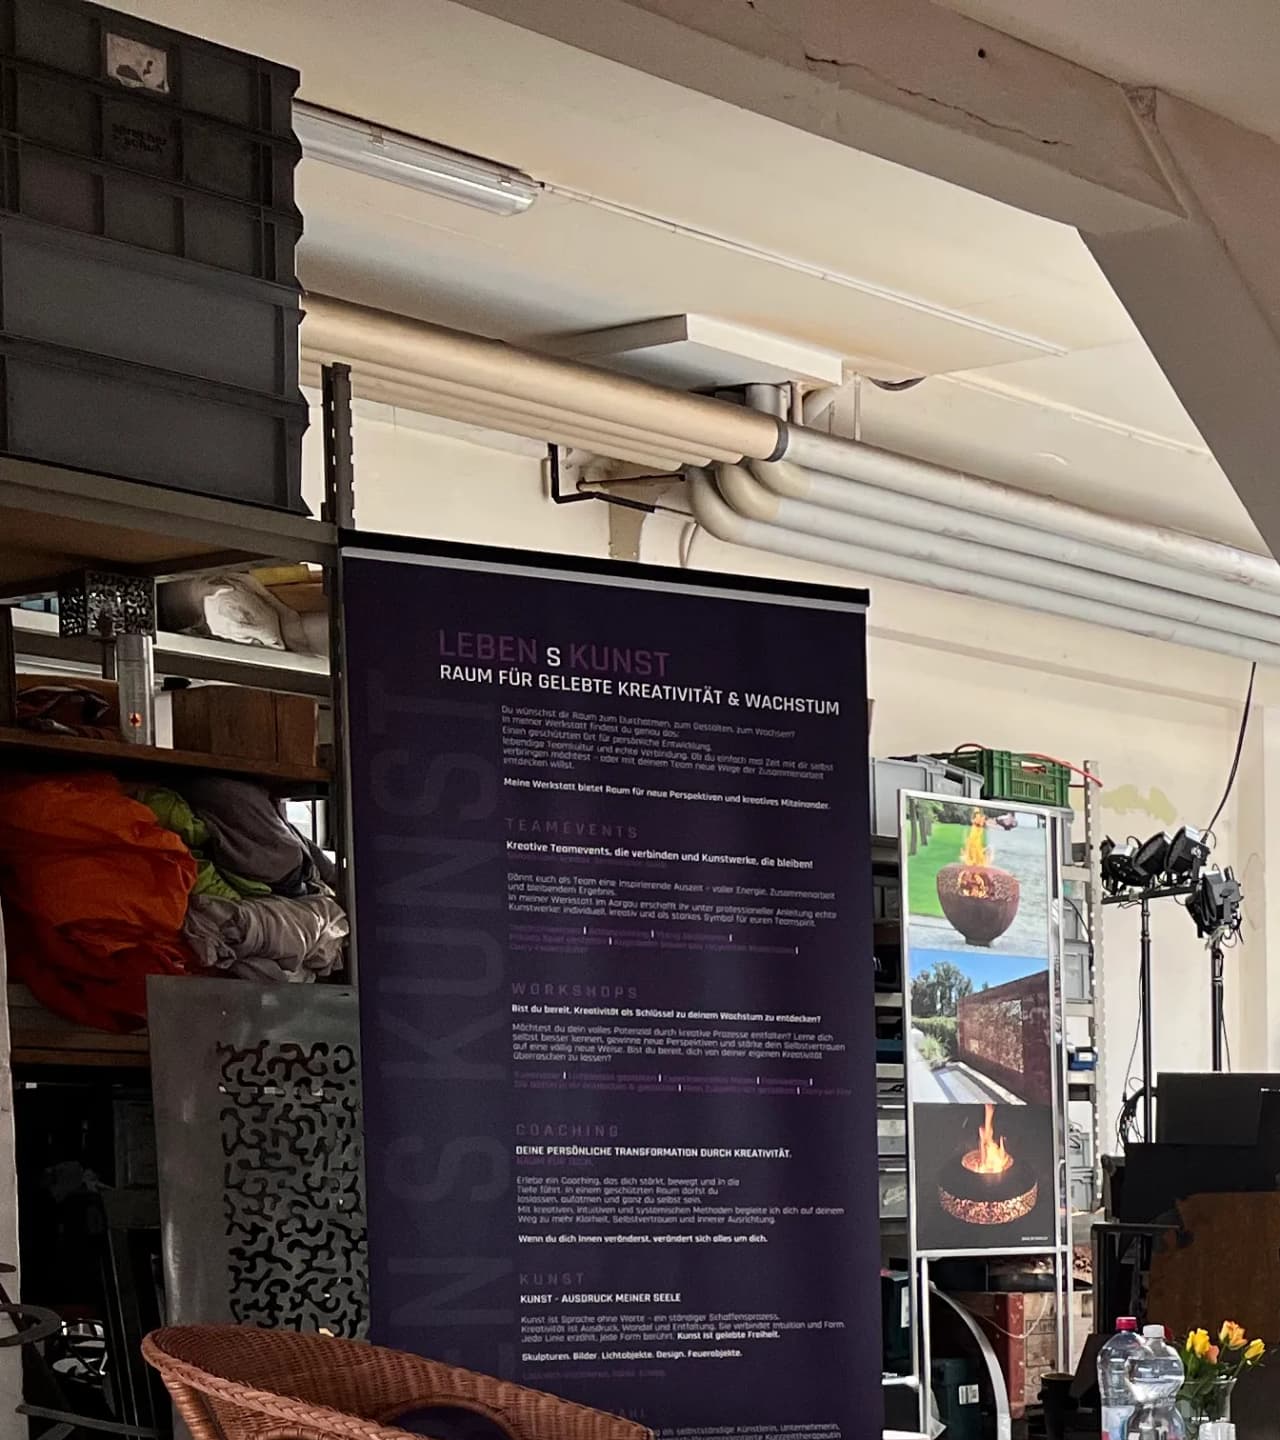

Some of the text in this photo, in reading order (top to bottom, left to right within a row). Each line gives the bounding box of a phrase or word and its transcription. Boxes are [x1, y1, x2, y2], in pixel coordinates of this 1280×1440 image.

[439, 628, 671, 678] LEBEN S KUNST
[440, 666, 840, 716] RAUM FÜR GELEBTE KREATIVITÄT & WACHSTUM
[502, 706, 513, 714] Du
[504, 778, 530, 787] Meine
[532, 780, 574, 790] Werkstatt
[578, 783, 602, 792] bietet
[605, 785, 630, 794] Raum
[632, 787, 644, 795] für
[669, 790, 723, 802] Perspektiven
[724, 794, 740, 802] und
[742, 795, 778, 804] kreatives
[781, 798, 832, 808] Miteinander.
[504, 817, 639, 838] TEAMEVENTS
[506, 841, 547, 852] Kreative
[614, 848, 629, 857] die
[631, 849, 678, 860] verbinden
[681, 852, 699, 861] und
[760, 857, 774, 866] die
[777, 858, 814, 868] bleiben!
[511, 982, 638, 999] WORKSHOPS
[512, 1004, 528, 1013] Bist
[530, 1005, 542, 1013] du
[574, 1007, 618, 1016] Kreativität
[620, 1008, 633, 1016] als
[635, 1009, 674, 1017] Schlüssel
[687, 1011, 718, 1019] deinem
[720, 1012, 763, 1021] Wachstum
[776, 1014, 822, 1022] entdecken?
[515, 1123, 619, 1137] COACHING
[516, 1144, 792, 1157] DEINE PERSÖNLICHE TRANSFORMATION DURCH KREATIVITÄT.
[519, 1272, 585, 1286] KUNST
[520, 1294, 552, 1303] KUNST
[561, 1294, 612, 1303] AUSDRUCK
[615, 1293, 650, 1302] MEINER
[653, 1293, 681, 1302] SEELE
[677, 1332, 700, 1340] Kunst
[715, 1332, 745, 1341] gelebte
[747, 1331, 780, 1339] Freiheit.
[687, 1350, 743, 1360] Feuerobjekte.
